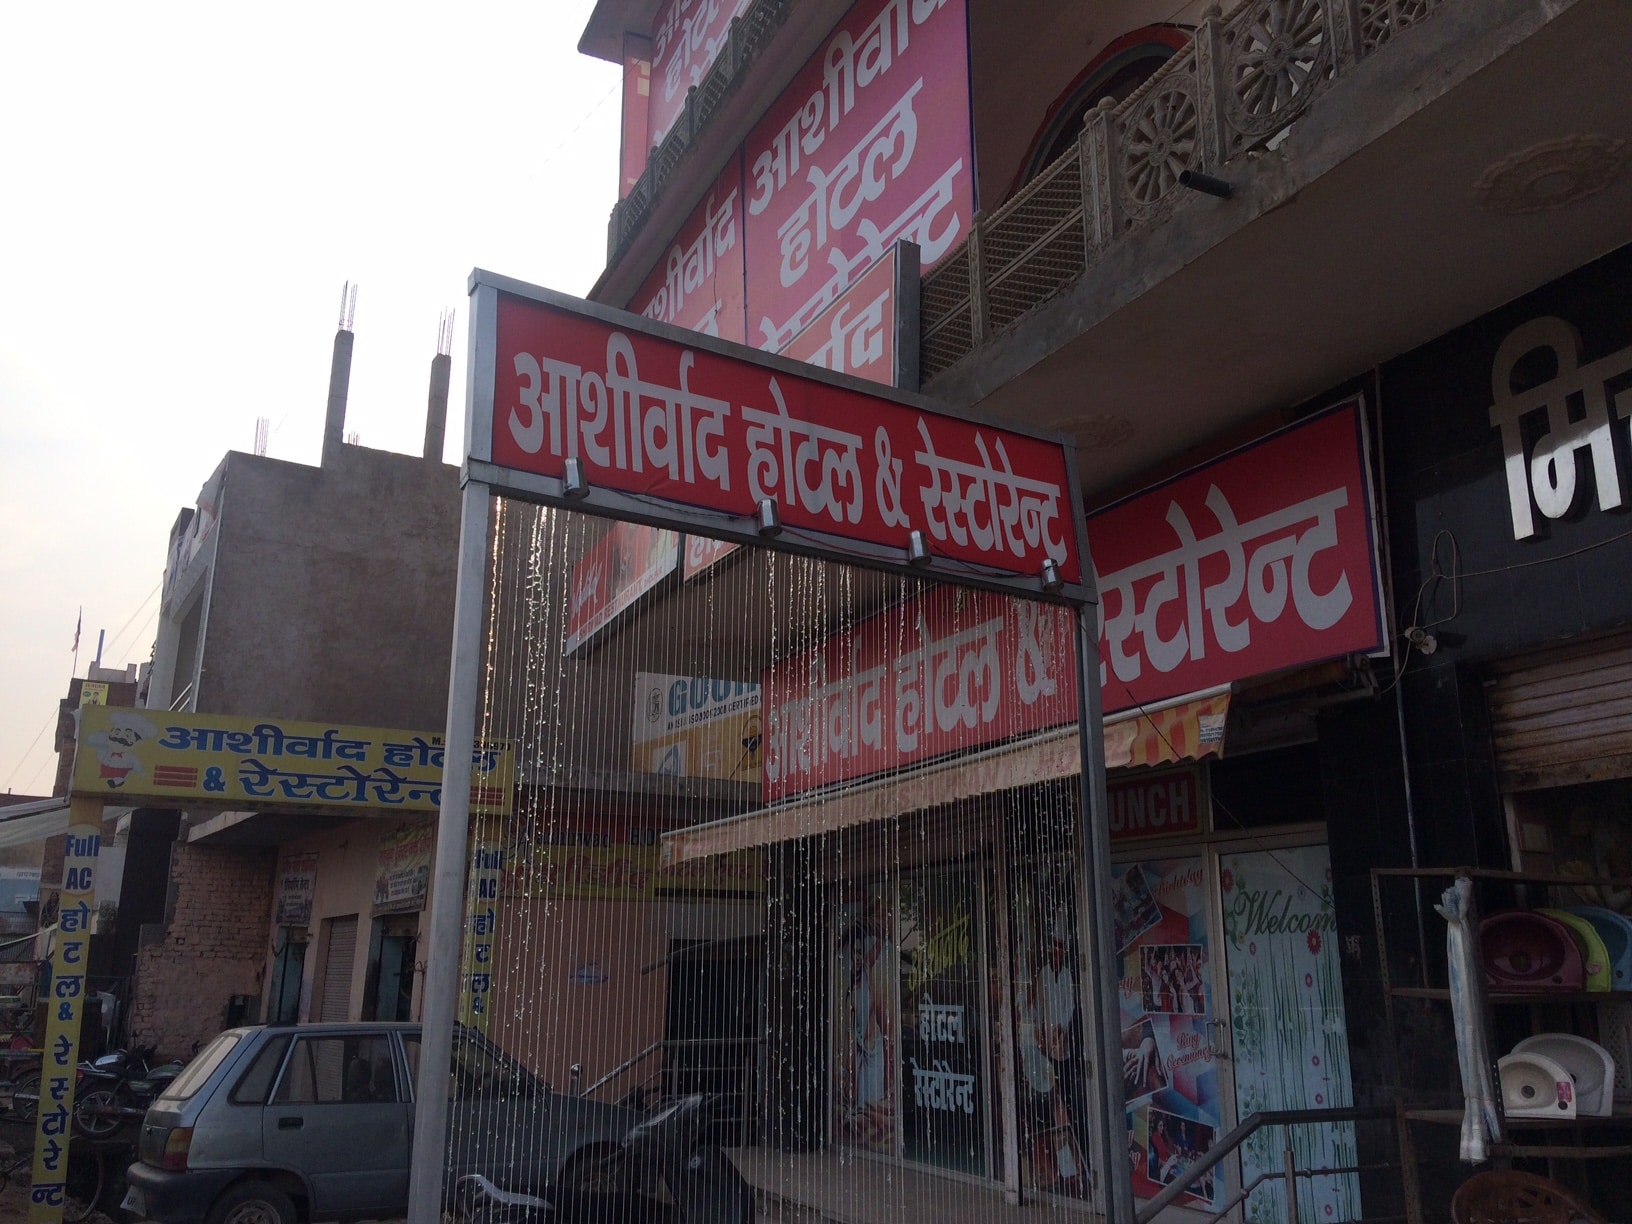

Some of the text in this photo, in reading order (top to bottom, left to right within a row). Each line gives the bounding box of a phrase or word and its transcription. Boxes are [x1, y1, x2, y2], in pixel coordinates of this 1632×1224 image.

[777, 77, 923, 288] होटल
[507, 331, 731, 491] आशीर्वाद
[742, 376, 862, 524] होटल
[875, 425, 910, 529] &
[914, 416, 1069, 569] रेस्टोरेन्ट
[893, 612, 1004, 754] होटल
[1015, 600, 1058, 706] &
[158, 722, 371, 762] आशीर्वाद
[202, 765, 227, 793] &
[1107, 780, 1190, 832] UNCH
[66, 834, 100, 857] Full
[66, 867, 92, 890] AC
[479, 878, 497, 898] AC
[57, 1002, 74, 1021] &
[918, 992, 965, 1044] होटल
